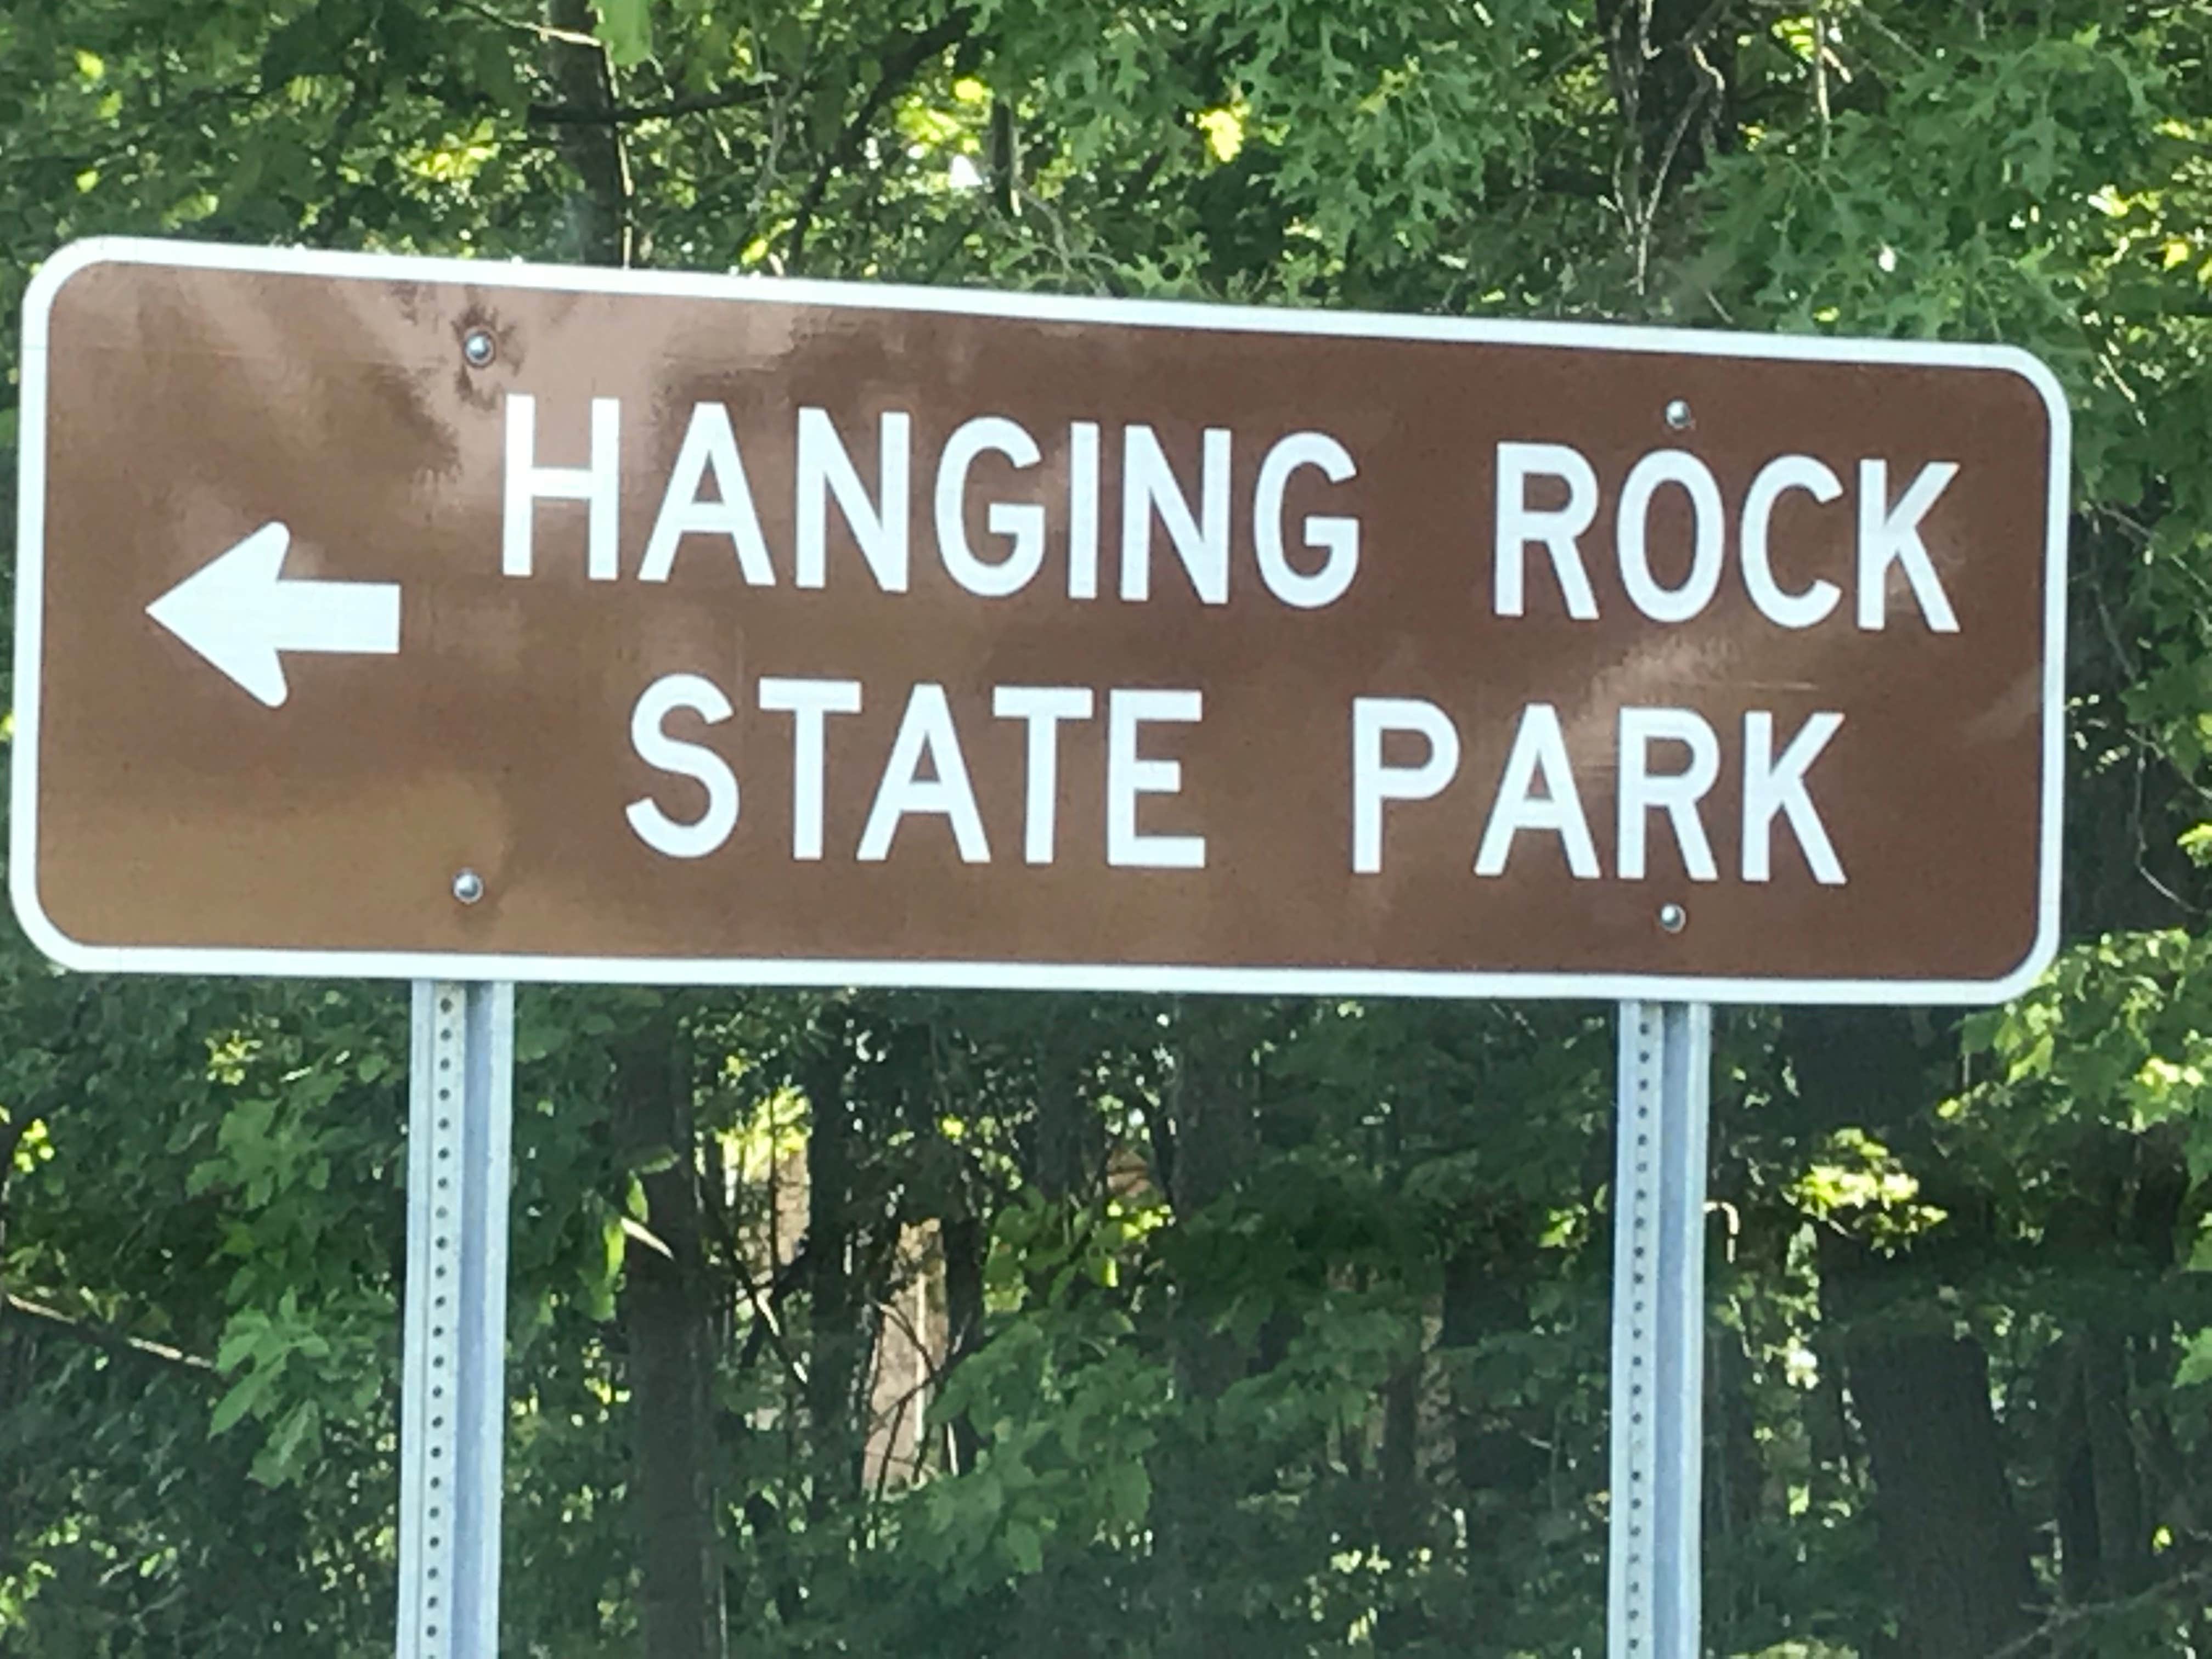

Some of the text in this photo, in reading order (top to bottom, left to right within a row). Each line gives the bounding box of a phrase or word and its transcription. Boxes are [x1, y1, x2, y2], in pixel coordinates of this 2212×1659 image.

[500, 391, 1960, 632] HANGING ROCK
[625, 674, 1847, 884] STATE PARK
